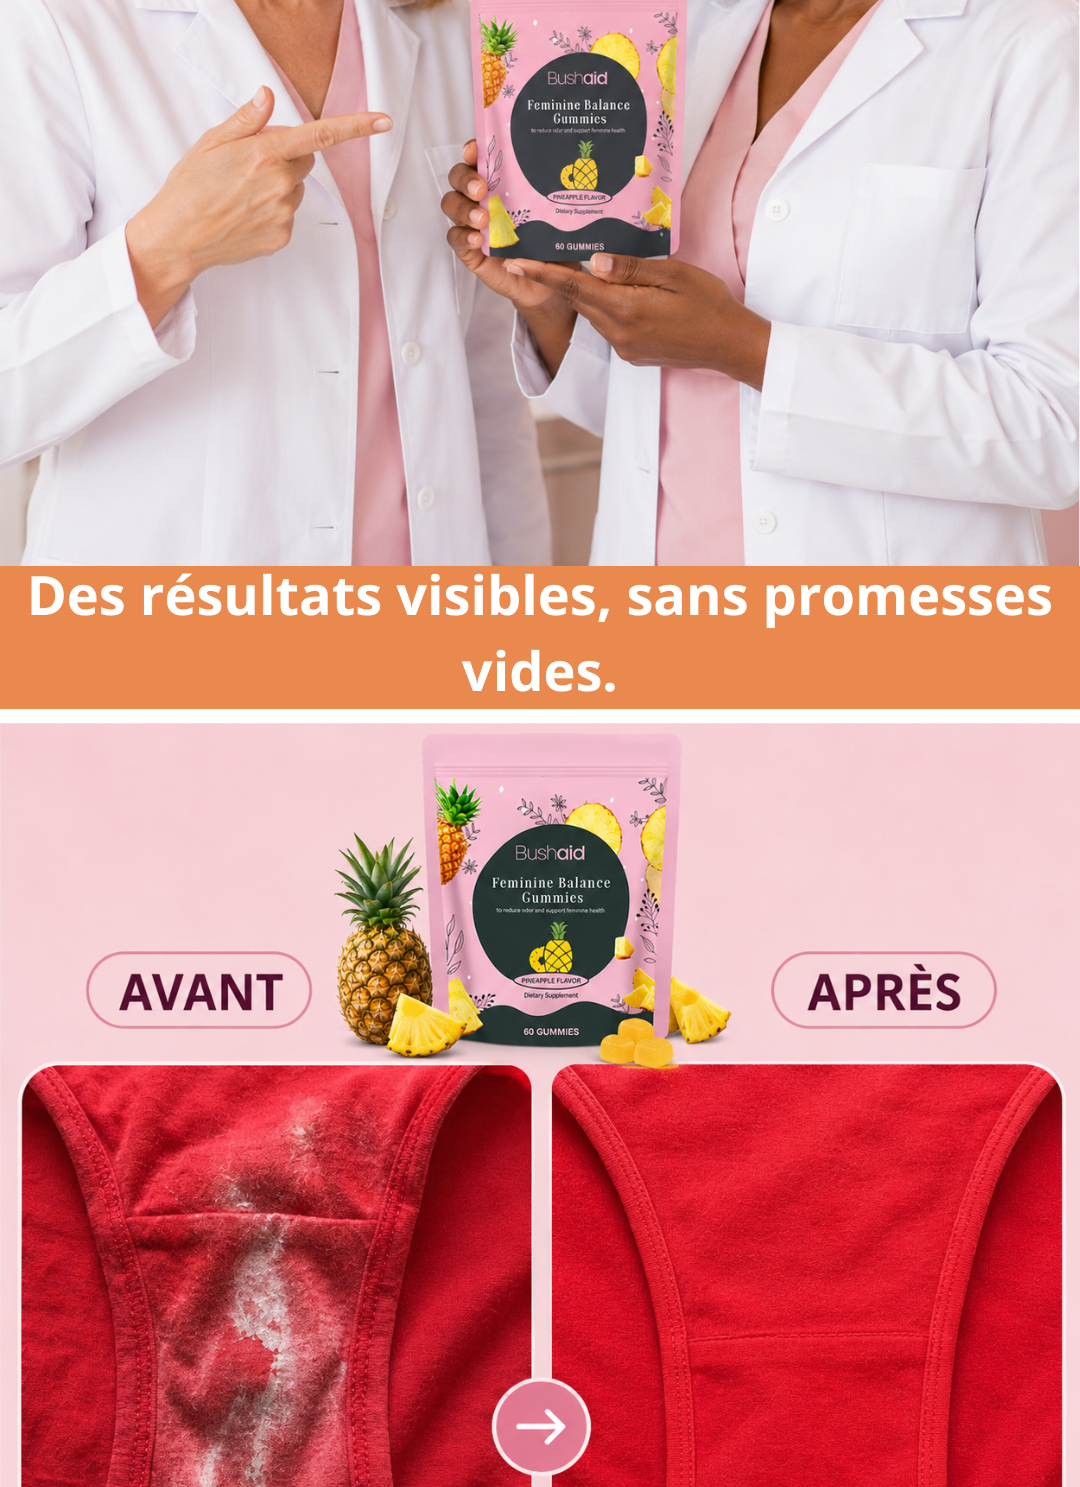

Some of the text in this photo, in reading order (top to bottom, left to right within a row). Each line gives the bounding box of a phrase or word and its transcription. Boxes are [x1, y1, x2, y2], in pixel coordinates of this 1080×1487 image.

[547, 71, 608, 86] Bushaid
[527, 98, 630, 111] Feminine Balance
[553, 112, 607, 125] Gummies
[566, 242, 605, 250] GUMMIES
[515, 844, 586, 861] Bushaid
[492, 876, 611, 889] Feminine Balance
[521, 891, 584, 904] Gummies
[524, 992, 544, 1000] Dietary
[523, 1027, 580, 1036] 60 GUMMIES
